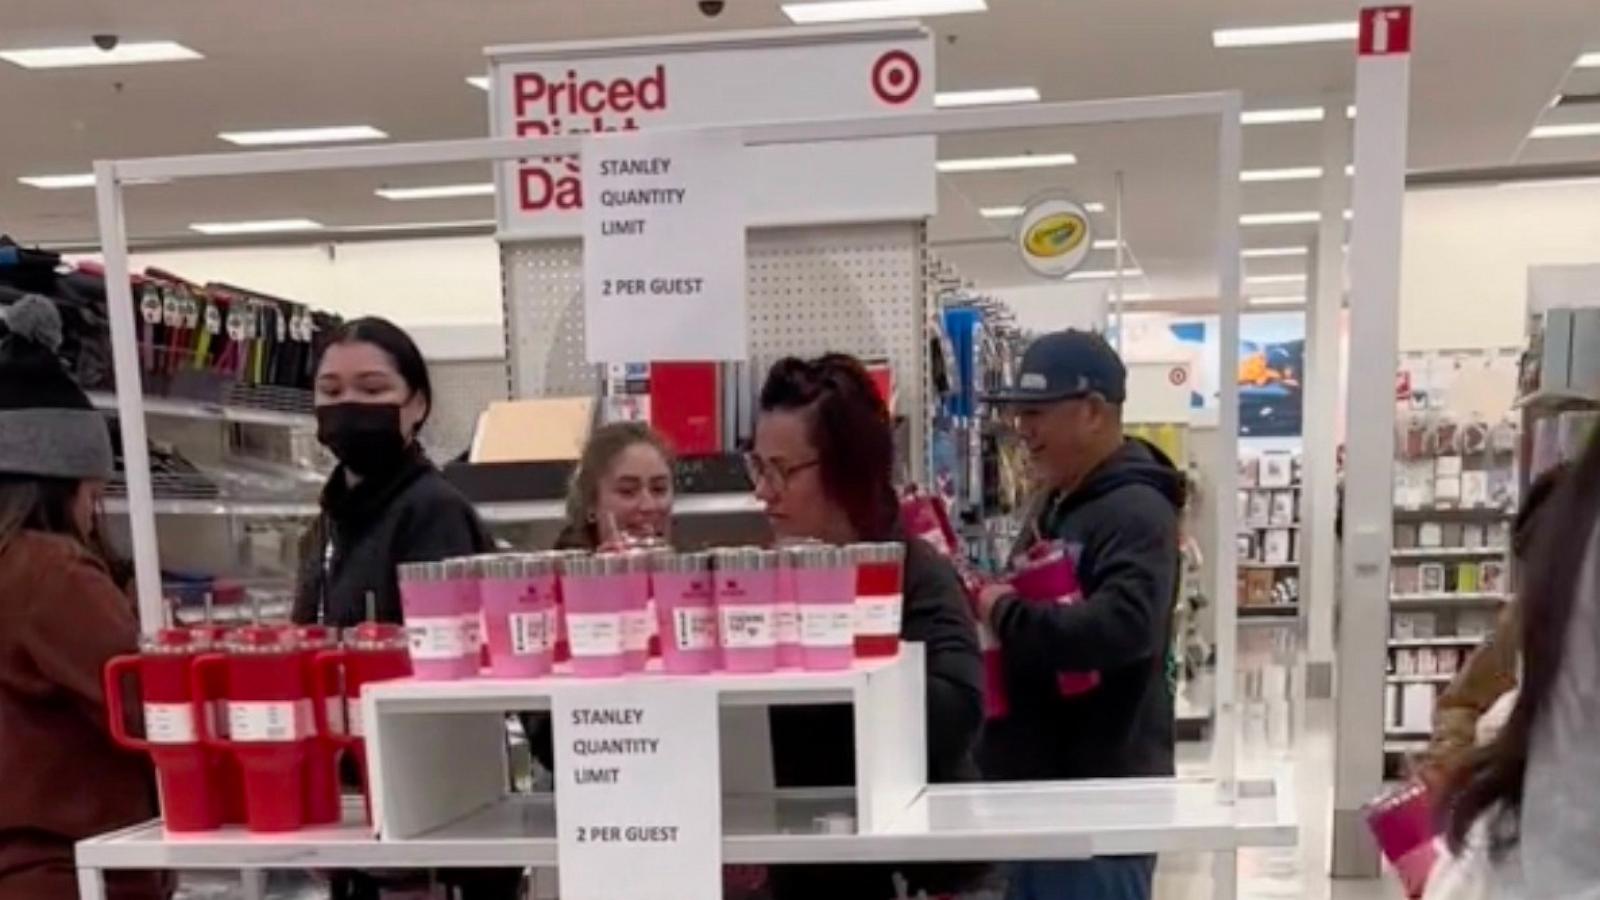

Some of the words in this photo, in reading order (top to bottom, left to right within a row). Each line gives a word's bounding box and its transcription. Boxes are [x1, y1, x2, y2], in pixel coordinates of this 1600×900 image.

[514, 65, 665, 117] Priced
[600, 158, 671, 175] STANLEY
[518, 167, 583, 210] Da
[601, 188, 686, 207] QUANTITY
[601, 220, 646, 236] LIMIT
[602, 278, 612, 295] 2
[616, 278, 646, 296] PER
[650, 277, 704, 296] GUEST
[572, 709, 643, 725] STANLEY
[573, 738, 659, 755] QUANTITY
[575, 768, 619, 784] LIMIT
[577, 826, 586, 842] 2
[591, 826, 622, 842] PER
[626, 826, 678, 842] GUEST
